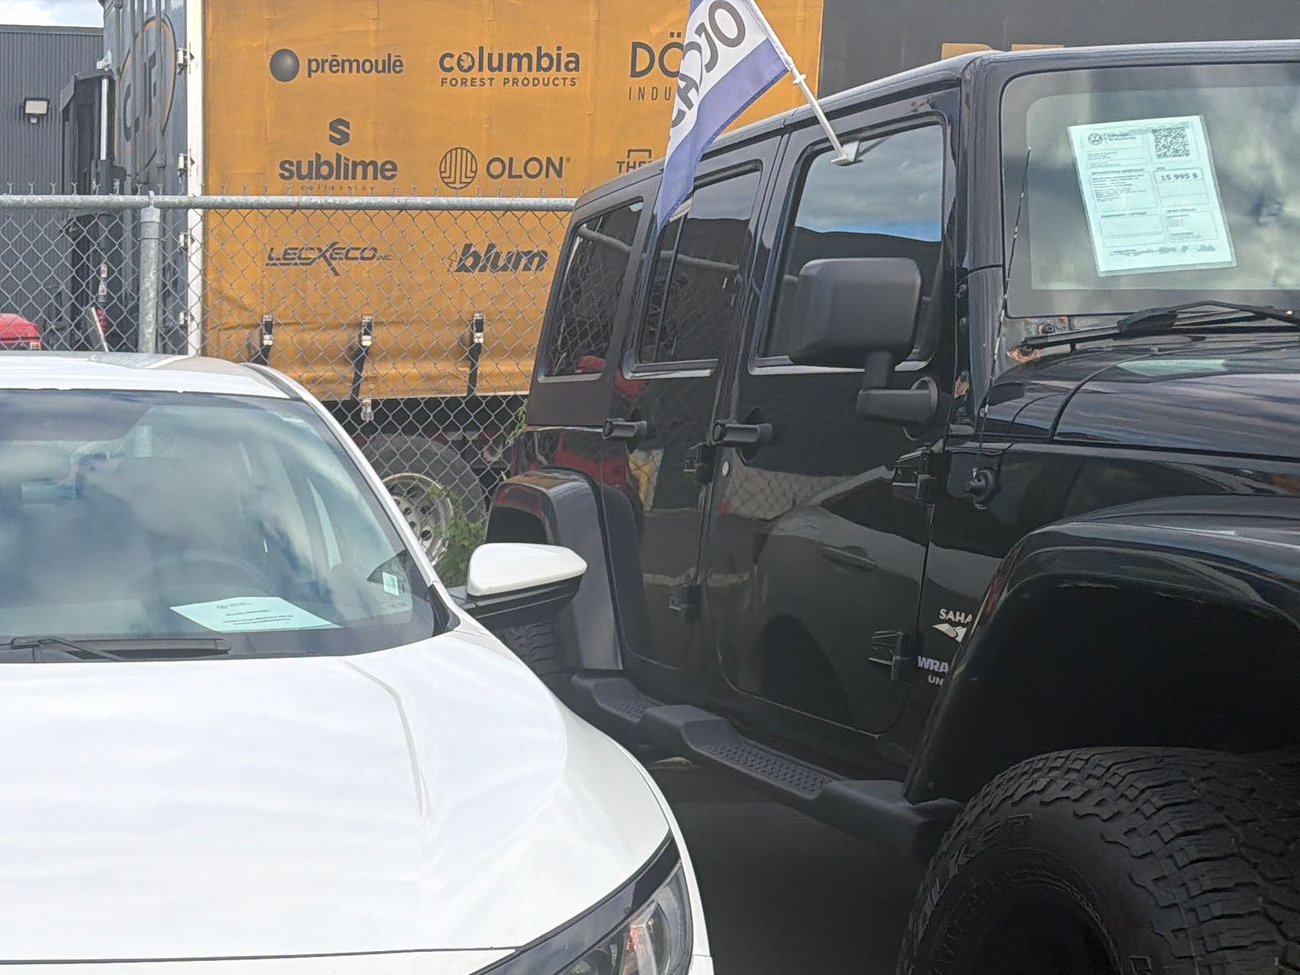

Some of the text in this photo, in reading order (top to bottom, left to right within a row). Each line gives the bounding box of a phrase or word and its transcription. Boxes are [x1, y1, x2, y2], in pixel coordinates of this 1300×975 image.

[439, 46, 580, 72] columbia
[441, 77, 576, 87] FOREST PRODUCTS
[278, 152, 398, 181] sublime
[486, 156, 564, 180] OLON
[455, 243, 549, 273] blum
[917, 655, 950, 674] WRA
[928, 675, 944, 686] UN
